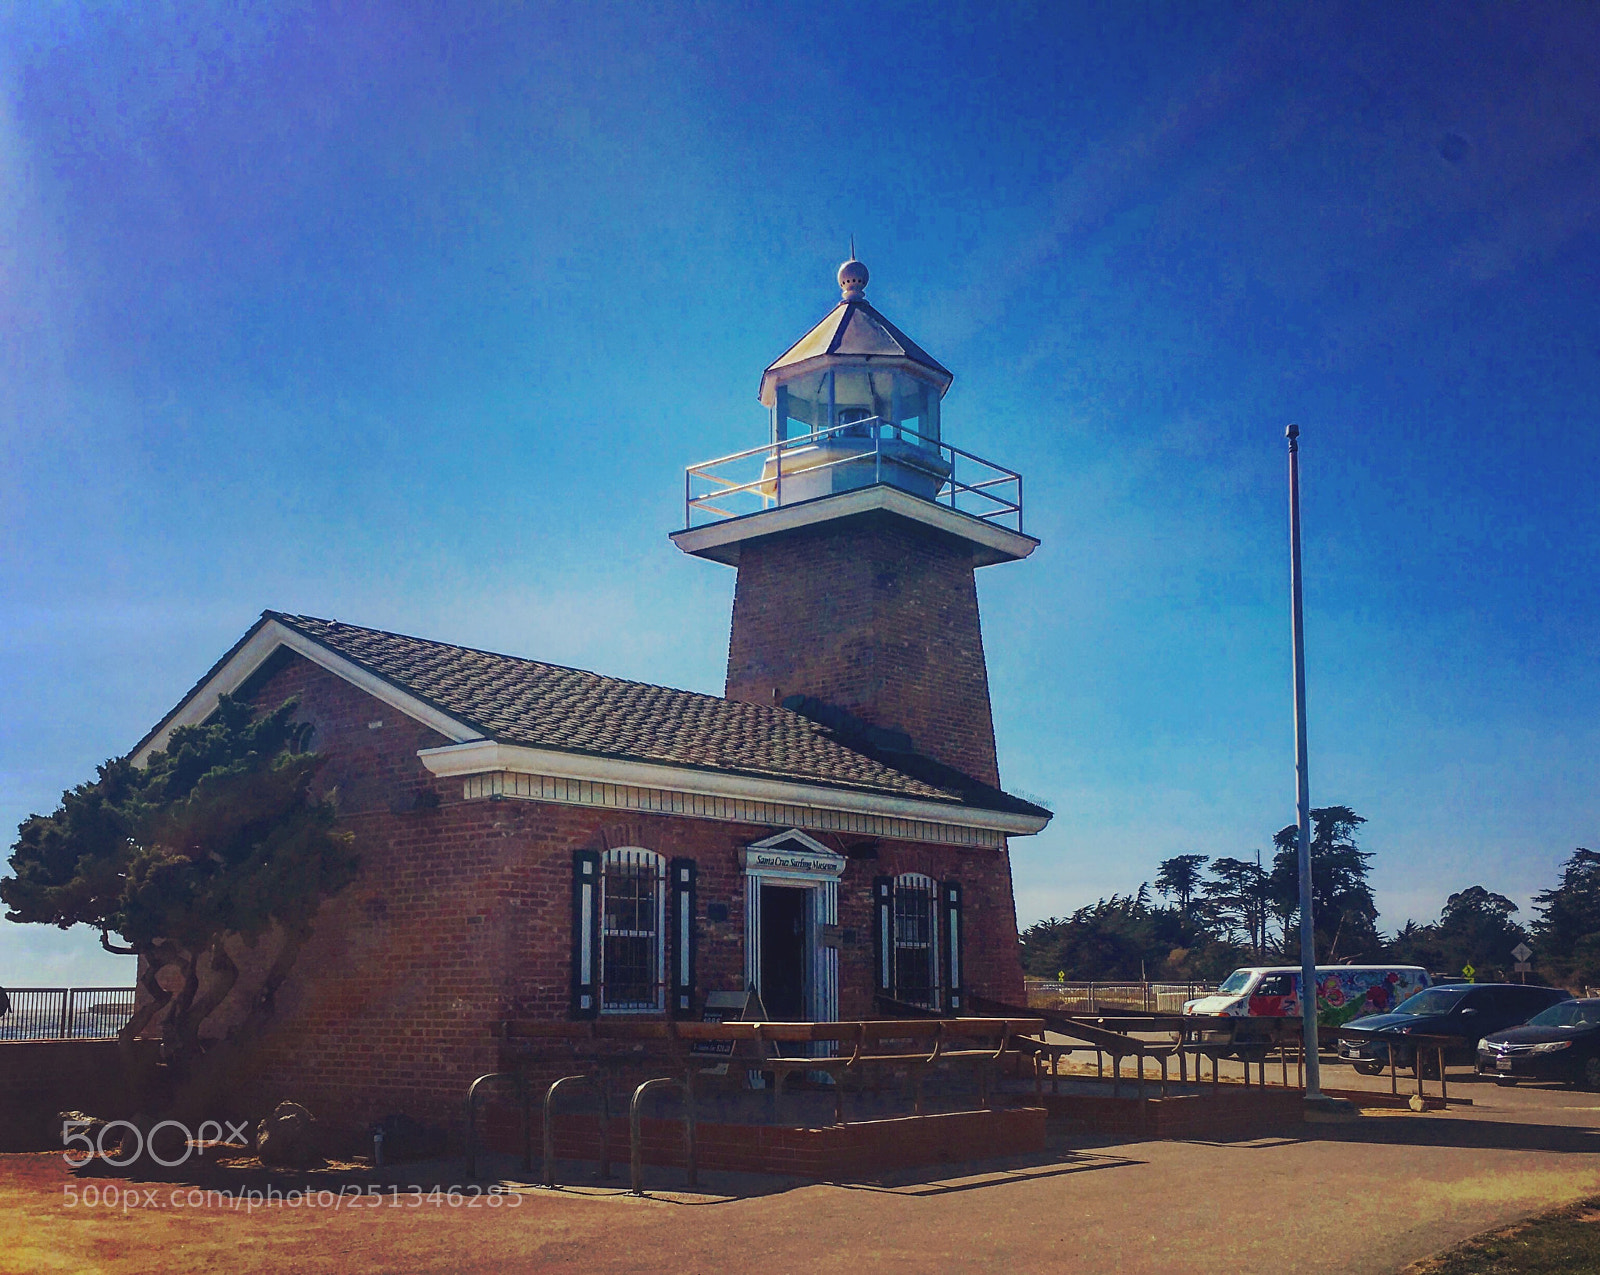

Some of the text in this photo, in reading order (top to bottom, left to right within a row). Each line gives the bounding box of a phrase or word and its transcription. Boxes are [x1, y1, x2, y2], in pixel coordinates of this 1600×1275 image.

[757, 855, 838, 871] Santa Cruz Surfing Museum
